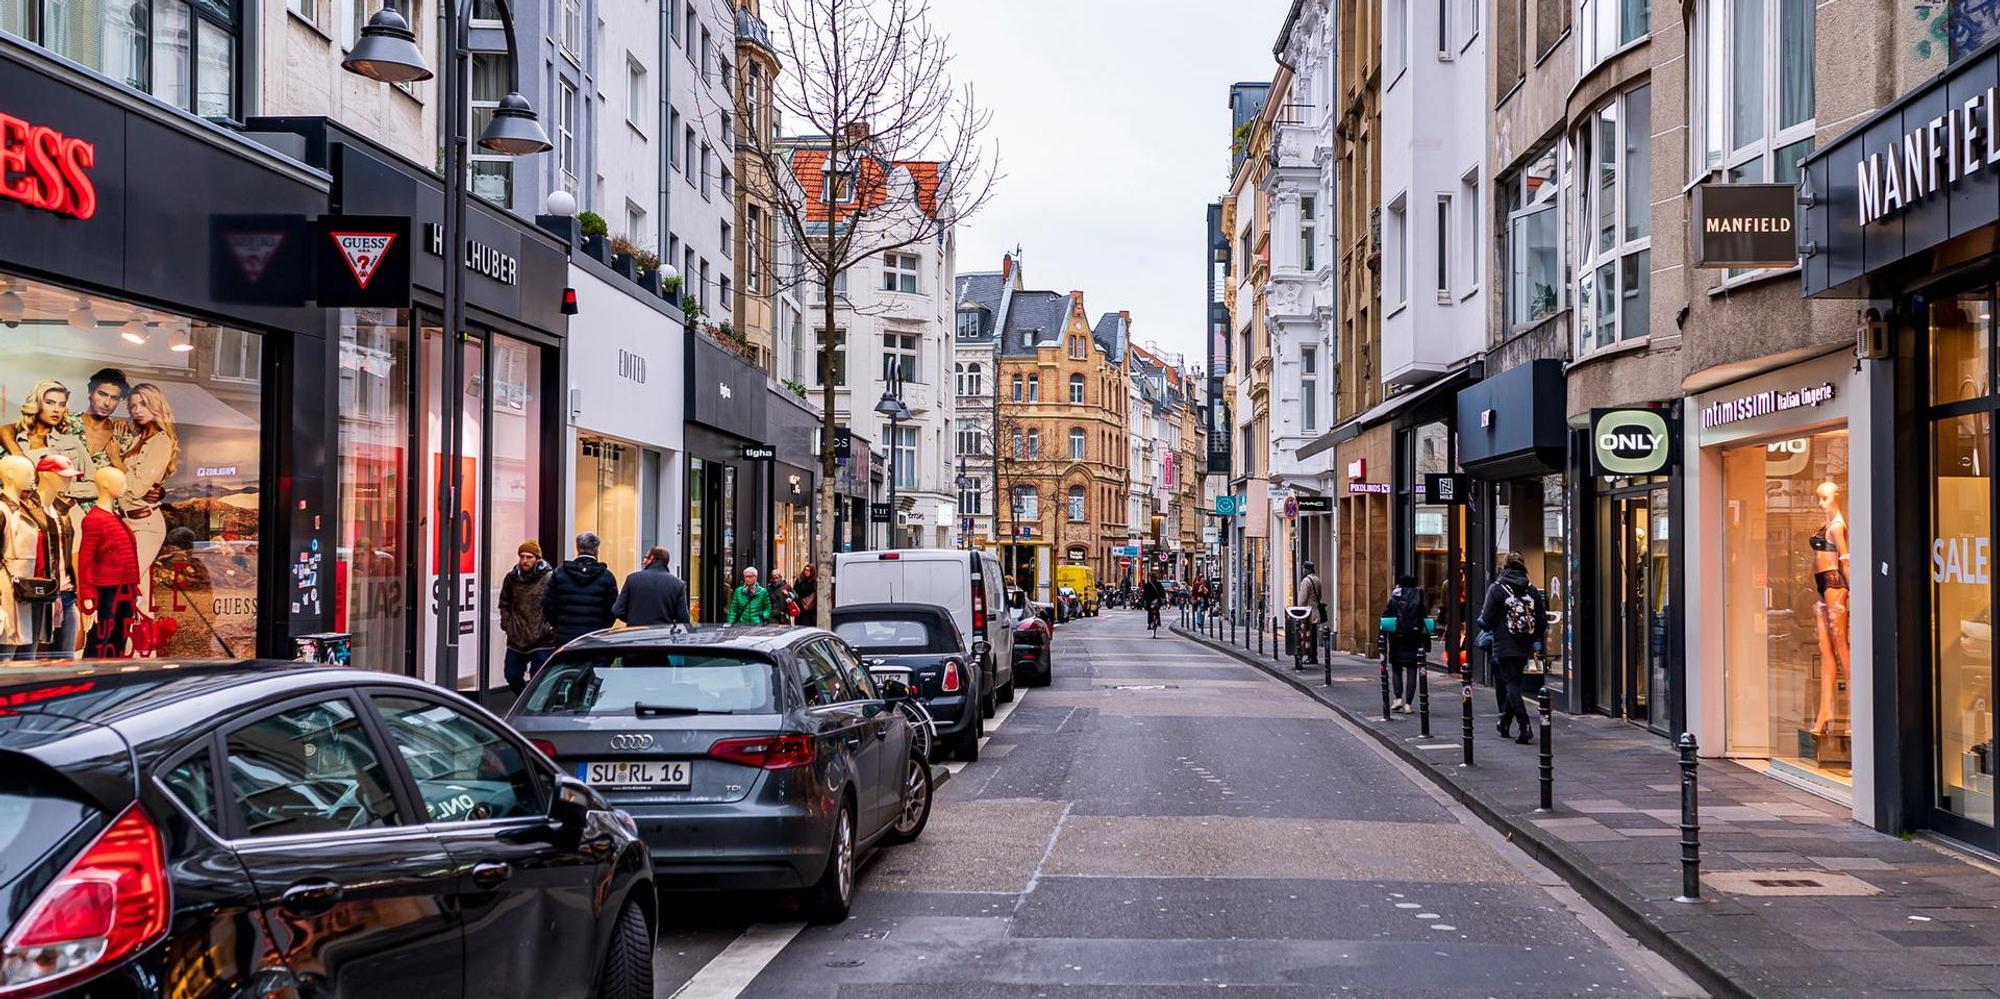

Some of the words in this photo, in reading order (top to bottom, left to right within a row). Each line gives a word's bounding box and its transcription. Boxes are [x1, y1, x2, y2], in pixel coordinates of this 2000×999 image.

[1706, 217, 1791, 233] MANFIELD
[342, 237, 385, 249] GUESS
[619, 348, 646, 385] EDITED
[1599, 433, 1664, 450] ONLY
[745, 448, 772, 458] tigha
[1350, 483, 1381, 493] PIKOLINOS
[1932, 537, 1989, 585] SALE
[591, 763, 617, 783] SU
[628, 763, 653, 783] RL
[659, 763, 684, 783] 16
